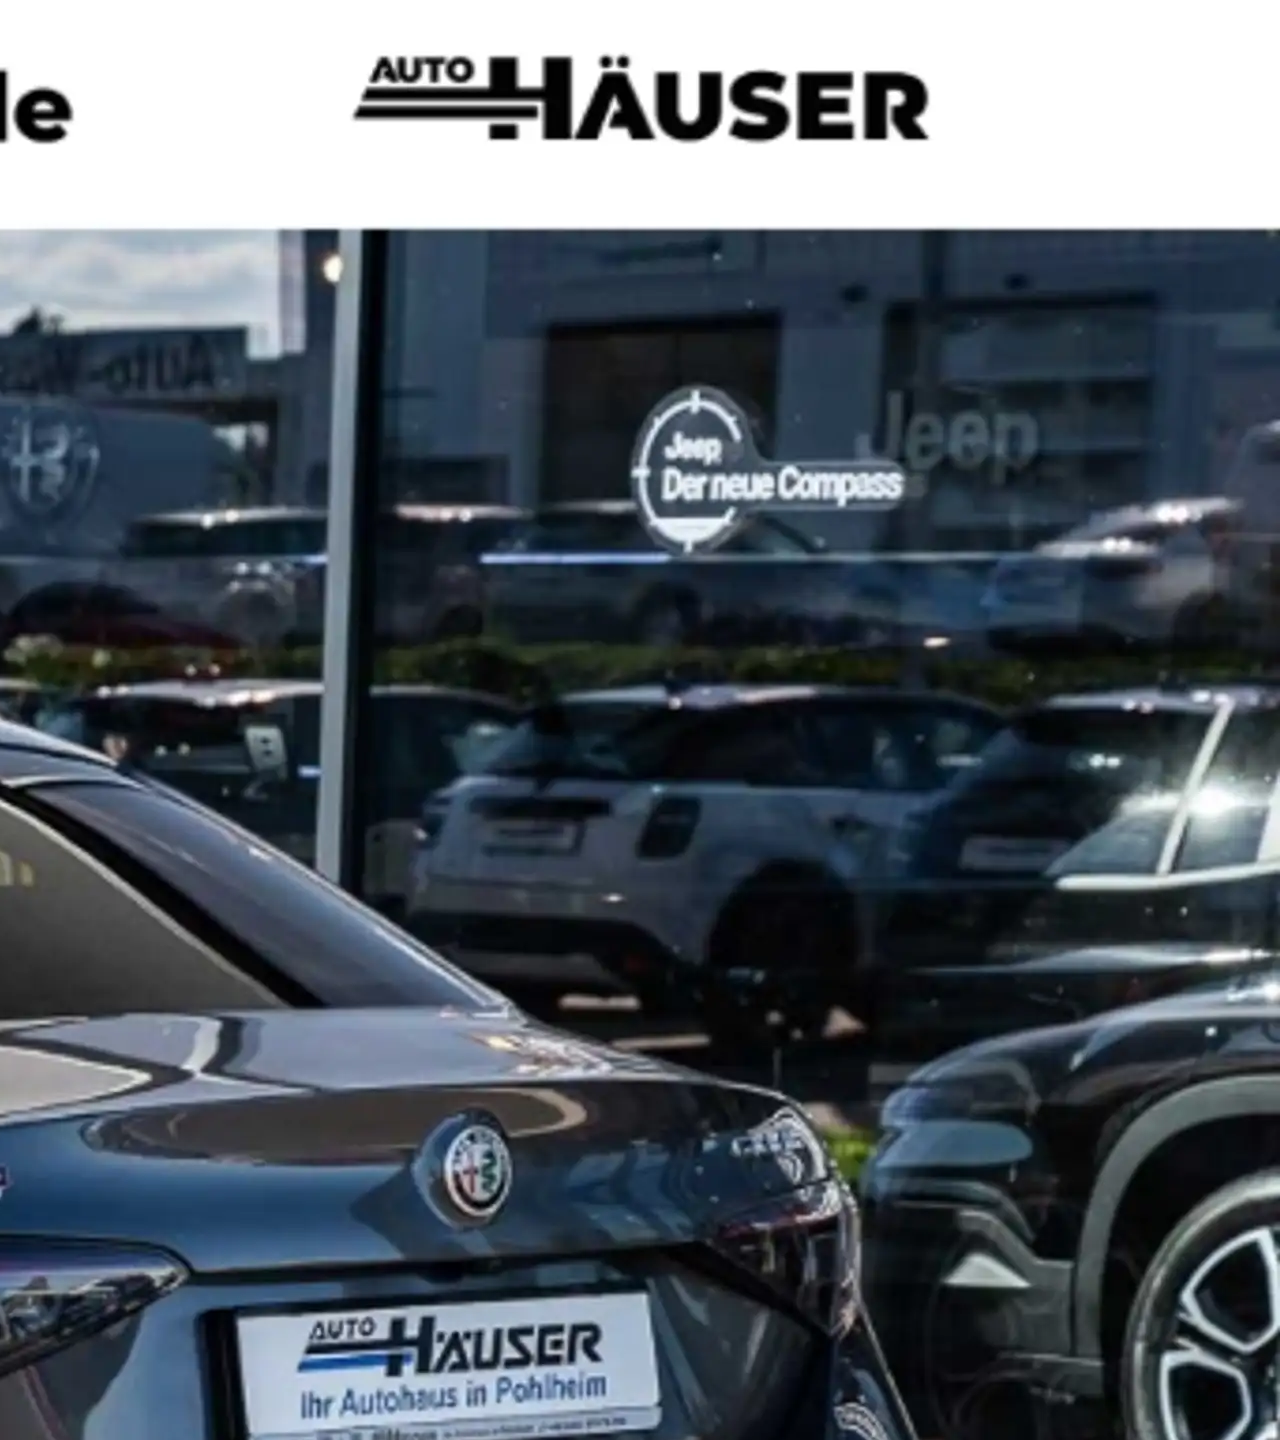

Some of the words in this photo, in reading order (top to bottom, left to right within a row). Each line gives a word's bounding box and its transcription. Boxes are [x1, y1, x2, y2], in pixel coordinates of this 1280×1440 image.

[664, 431, 723, 466] Jeep
[855, 390, 1039, 485] Jeep
[661, 466, 708, 501] Der
[709, 470, 775, 501] neue
[777, 464, 903, 508] Compass
[308, 1317, 378, 1341] AUTO
[384, 1315, 604, 1378] HÄUSER
[300, 1390, 331, 1420] Ihr
[338, 1385, 459, 1417] Autohaus
[465, 1380, 488, 1409] in
[495, 1372, 608, 1405] Pohlheim
